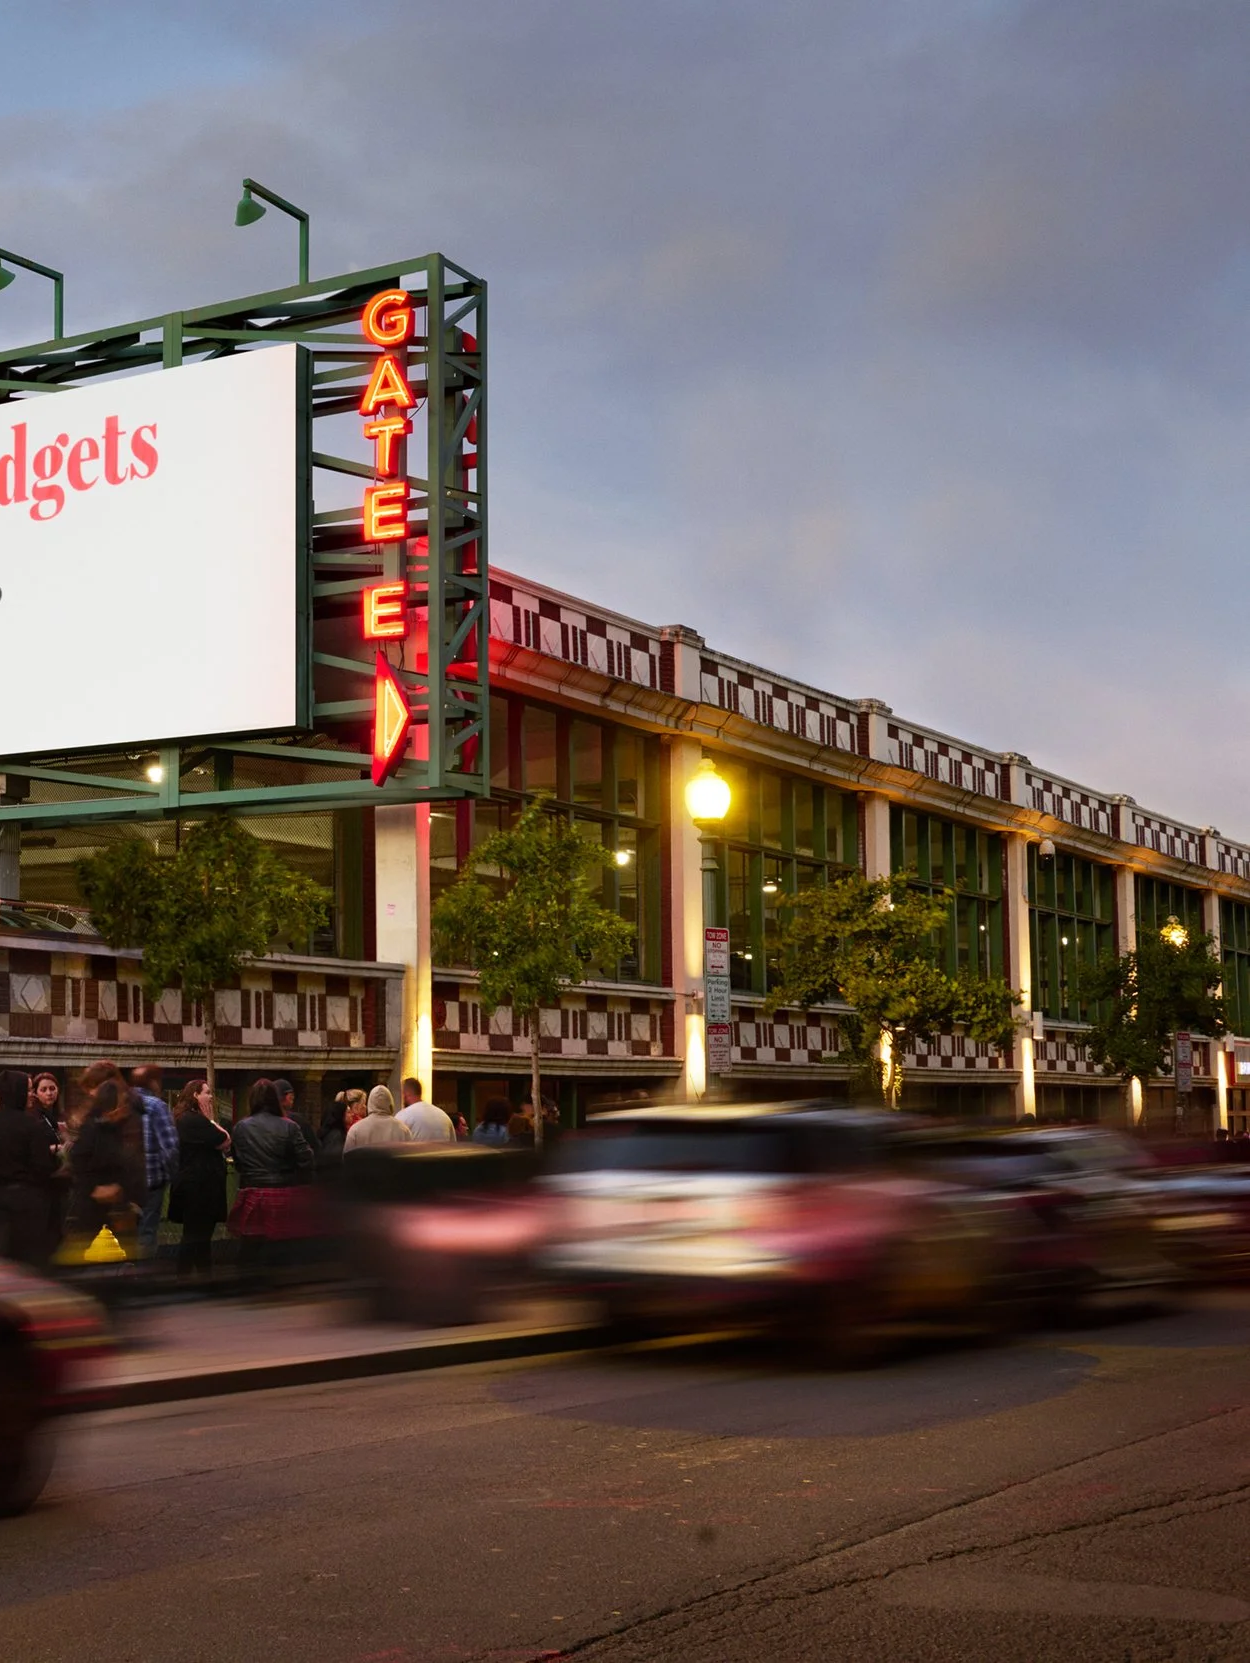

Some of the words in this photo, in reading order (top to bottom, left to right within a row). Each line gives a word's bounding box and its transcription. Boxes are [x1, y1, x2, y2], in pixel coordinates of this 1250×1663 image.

[359, 288, 417, 543] GATE
[362, 581, 409, 642] E
[707, 978, 728, 987] Parking
